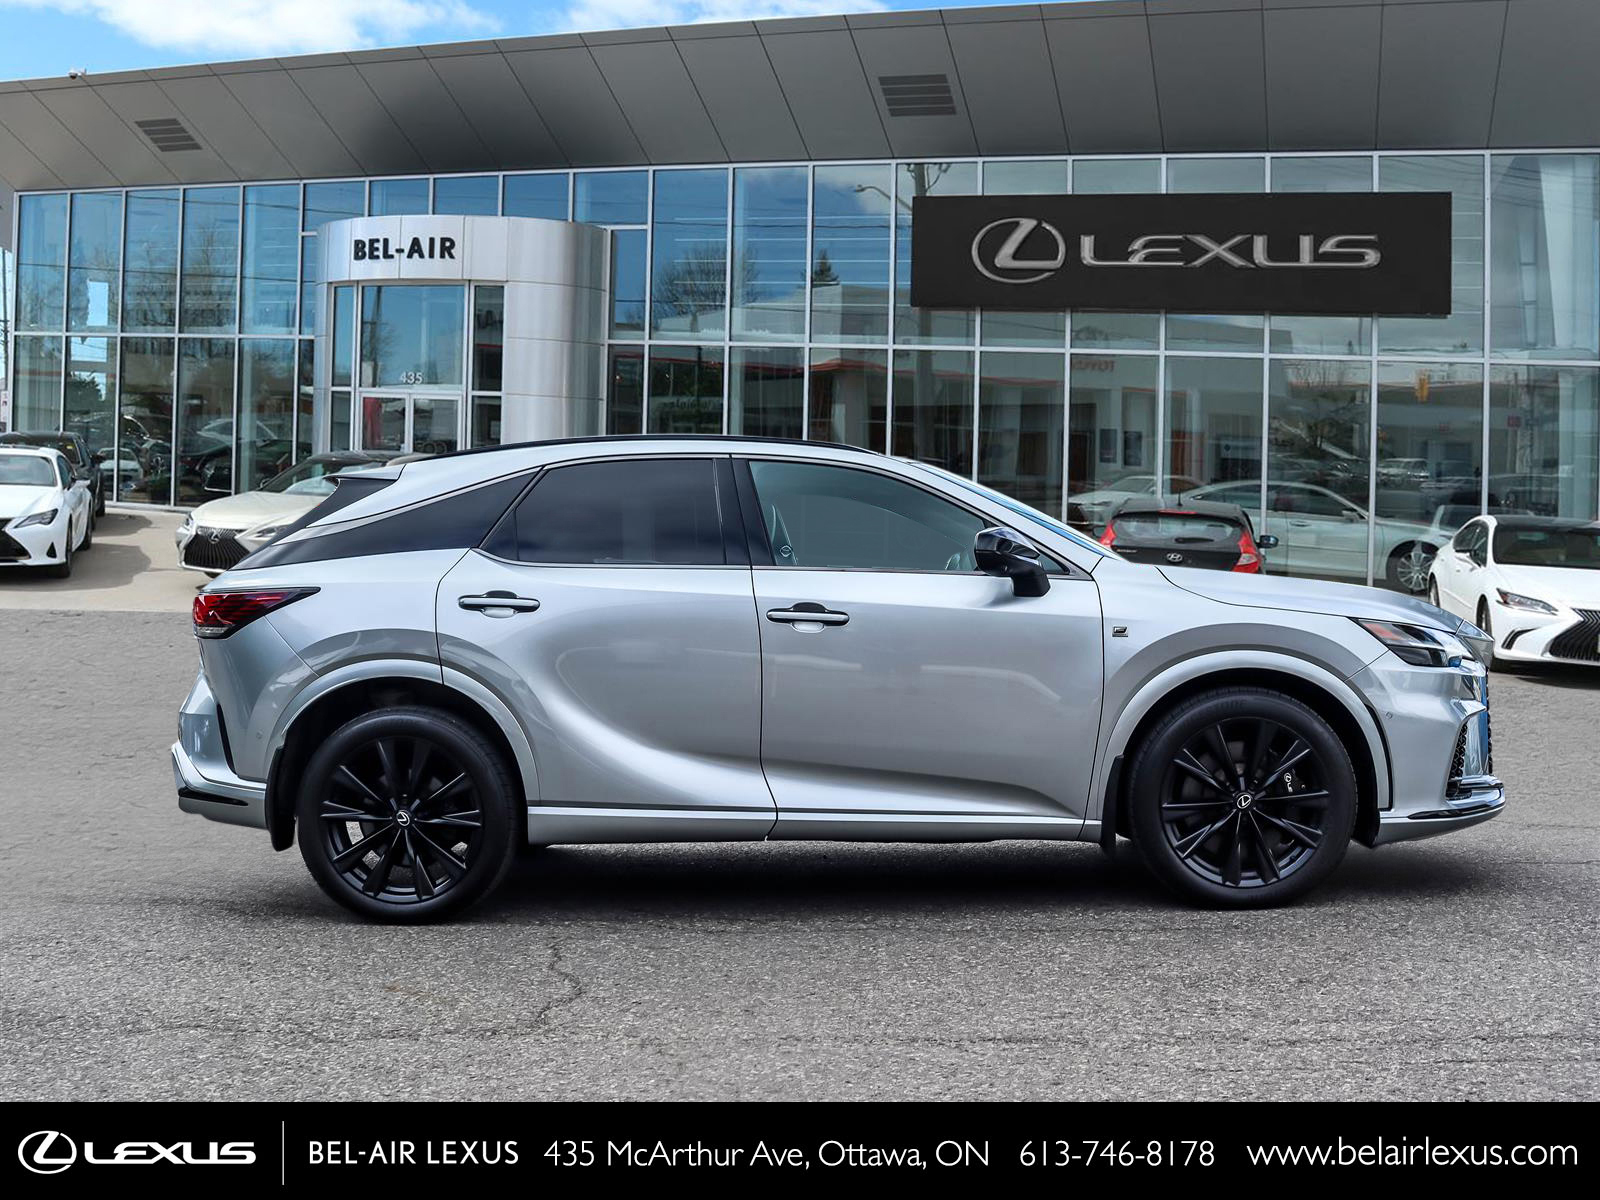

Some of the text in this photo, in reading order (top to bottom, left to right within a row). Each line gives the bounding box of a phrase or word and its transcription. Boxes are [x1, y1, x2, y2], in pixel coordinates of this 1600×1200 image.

[354, 237, 456, 260] BEL-AIR
[1080, 234, 1381, 268] LEXUS
[400, 371, 423, 384] 435
